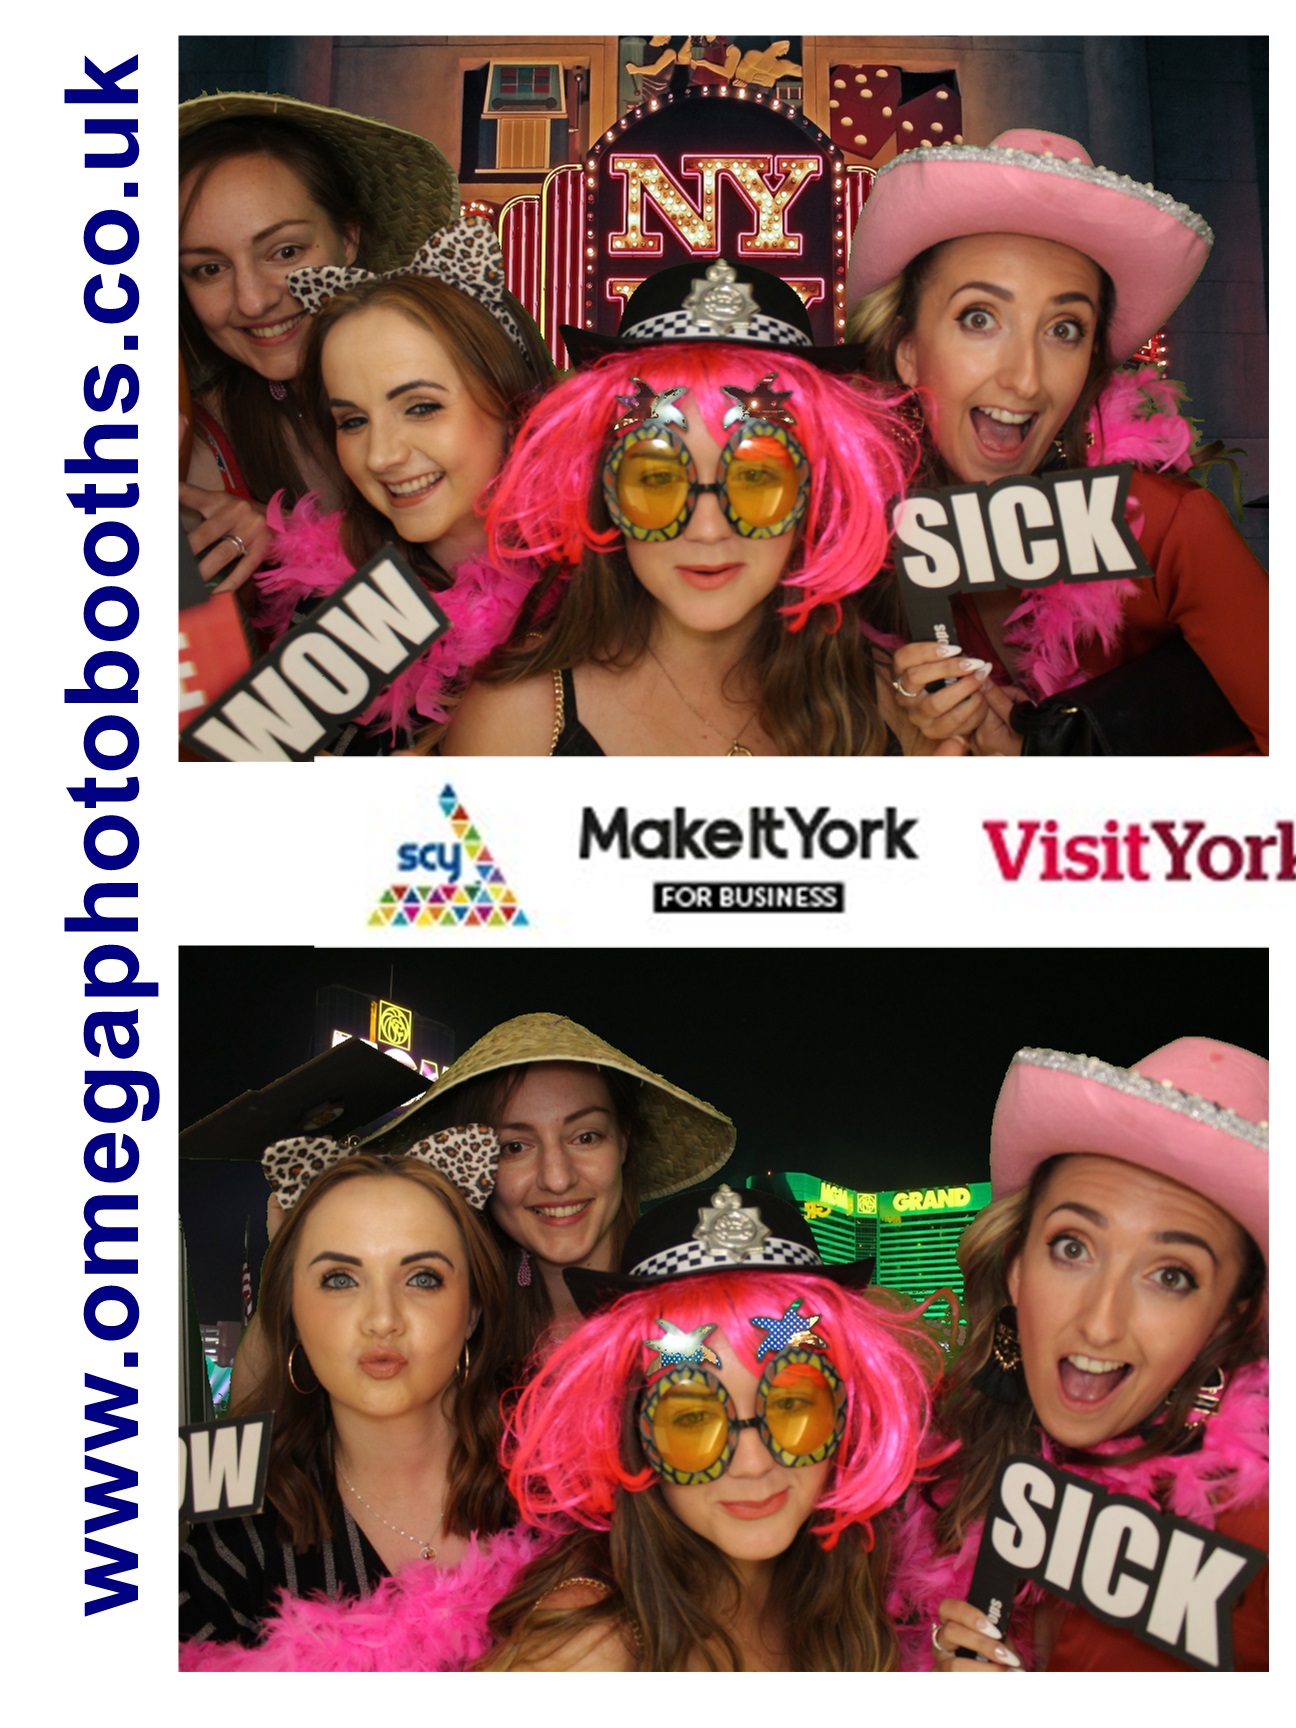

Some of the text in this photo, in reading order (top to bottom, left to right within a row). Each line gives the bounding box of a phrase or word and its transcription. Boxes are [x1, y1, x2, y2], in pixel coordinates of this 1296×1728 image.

[609, 153, 822, 256] NY
[893, 475, 1136, 589] SICK
[192, 559, 440, 762] WOW
[892, 1187, 971, 1212] GRAND
[990, 1461, 1247, 1668] SICK
